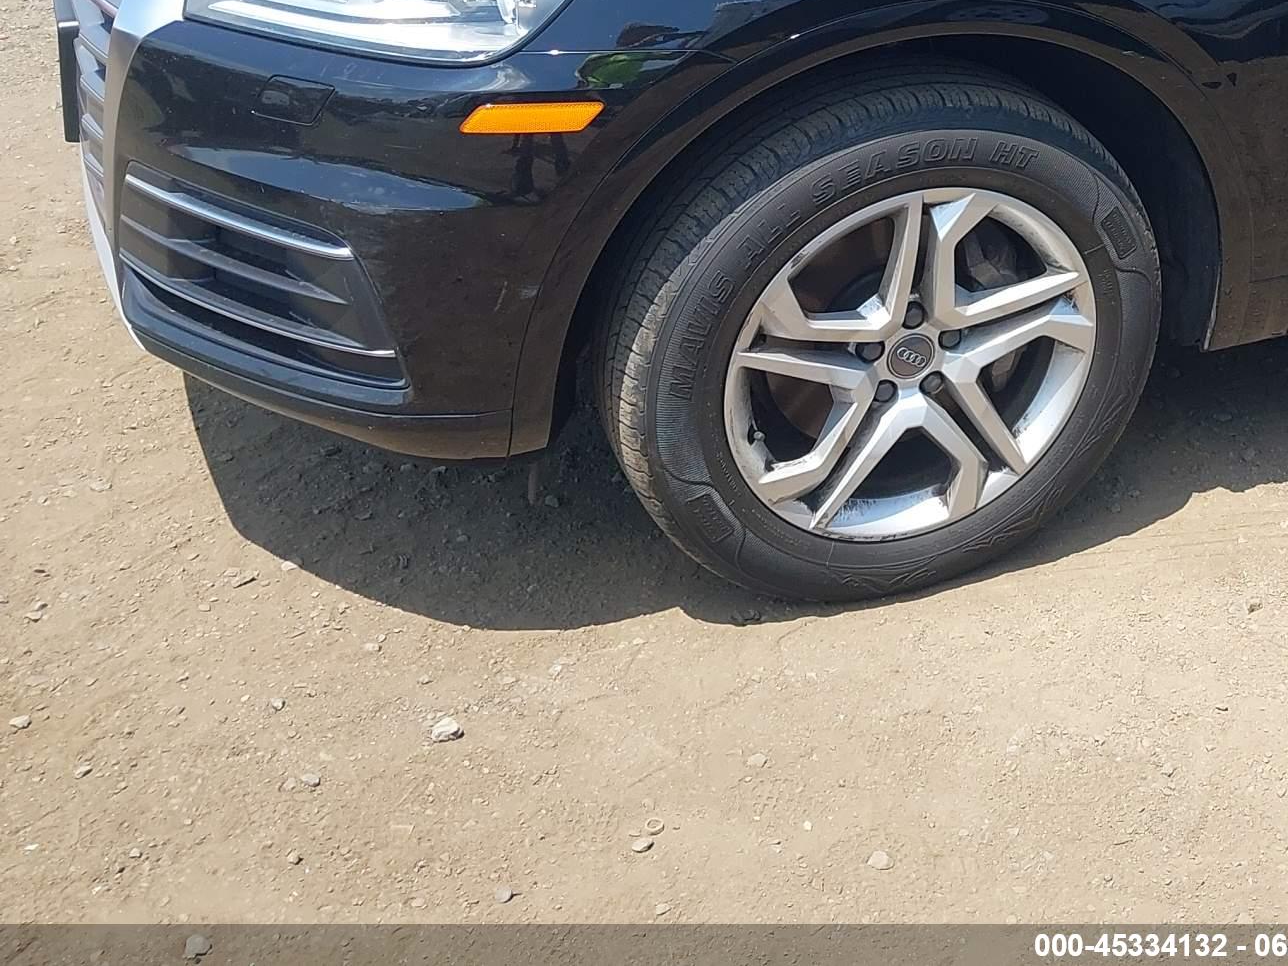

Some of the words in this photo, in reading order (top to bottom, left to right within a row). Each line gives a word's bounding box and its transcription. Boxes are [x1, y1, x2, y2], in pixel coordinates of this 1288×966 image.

[669, 270, 735, 401] MAVIS
[736, 202, 802, 269] ALL
[809, 137, 979, 205] SEASON
[988, 140, 1040, 170] HT
